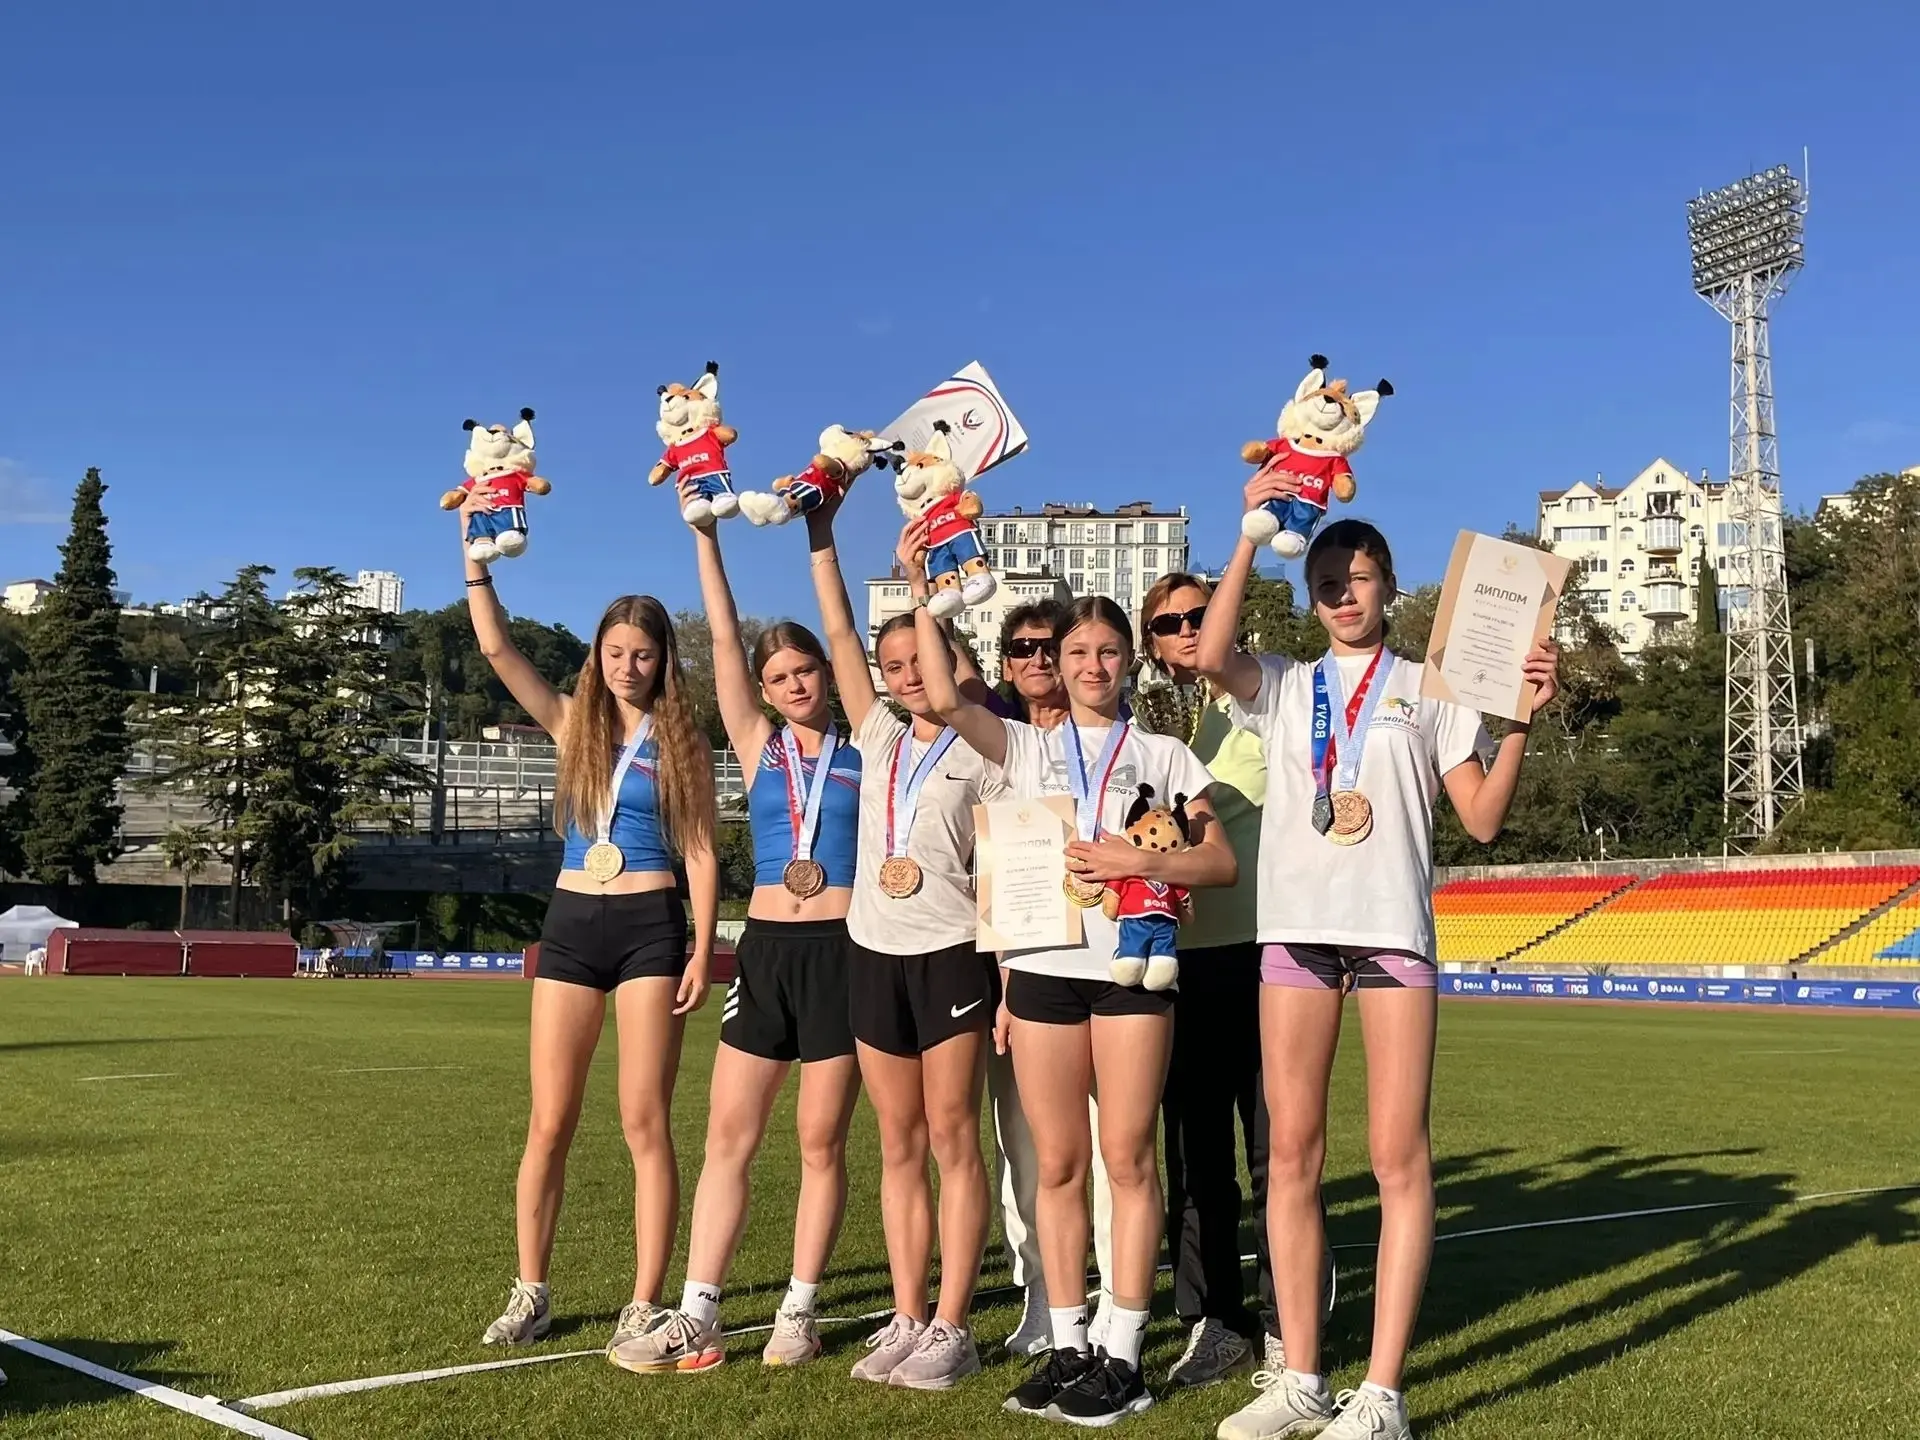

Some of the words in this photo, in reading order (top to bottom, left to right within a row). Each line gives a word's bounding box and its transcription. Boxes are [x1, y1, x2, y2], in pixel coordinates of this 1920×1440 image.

[1474, 583, 1528, 605] ДИПЛОМ
[1315, 703, 1328, 739] ВФЛА
[698, 1291, 717, 1303] FILA
